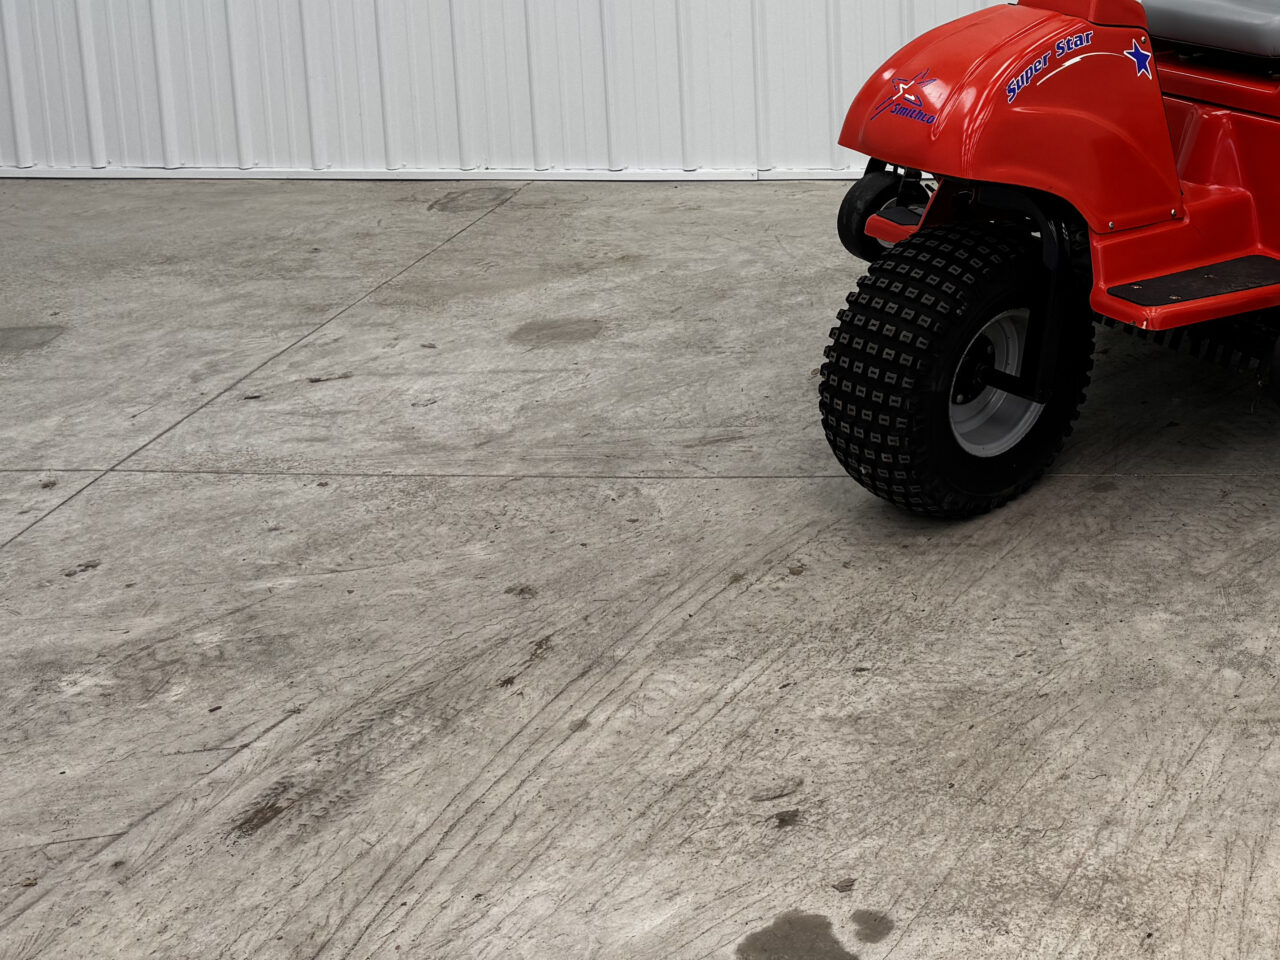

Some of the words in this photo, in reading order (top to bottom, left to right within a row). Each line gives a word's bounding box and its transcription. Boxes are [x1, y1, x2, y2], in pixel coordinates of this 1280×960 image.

[1006, 50, 1052, 104] Super
[1055, 30, 1094, 59] Star
[890, 102, 936, 124] Smithco
